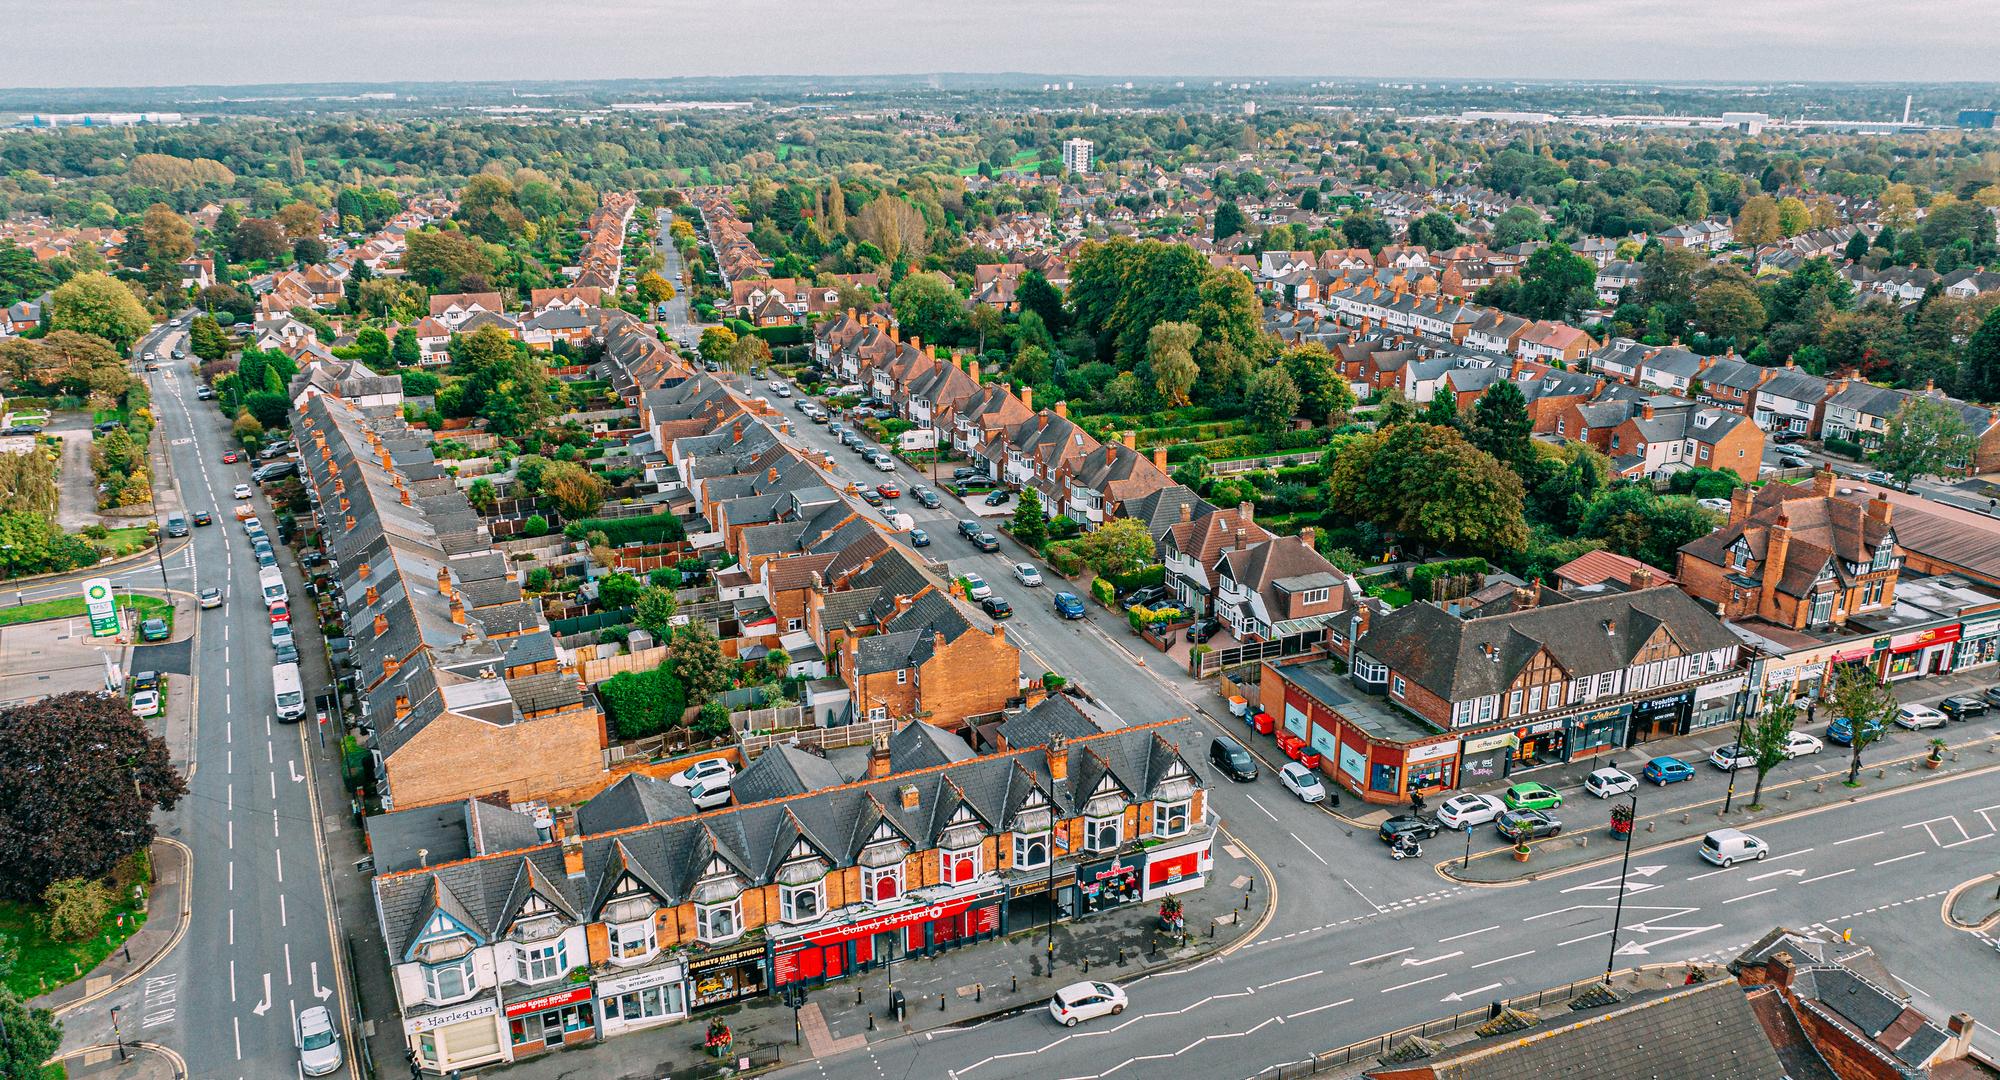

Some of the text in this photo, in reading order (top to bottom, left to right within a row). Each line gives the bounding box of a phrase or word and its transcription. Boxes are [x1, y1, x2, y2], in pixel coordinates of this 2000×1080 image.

[1651, 696, 1678, 706] Evolution
[1532, 721, 1552, 734] BURGER
[1477, 741, 1492, 749] coffee
[842, 910, 928, 935] Convey Us Legal
[690, 957, 718, 969] HARRYS
[719, 953, 738, 963] HAIR
[738, 947, 765, 957] STUDIO
[629, 978, 654, 987] INTERIORS
[142, 973, 177, 1029] NO ENTRY
[506, 1002, 526, 1012] HONG
[528, 997, 548, 1007] KONG
[549, 992, 572, 1001] HOUSE
[427, 1005, 493, 1026] Harlequin
